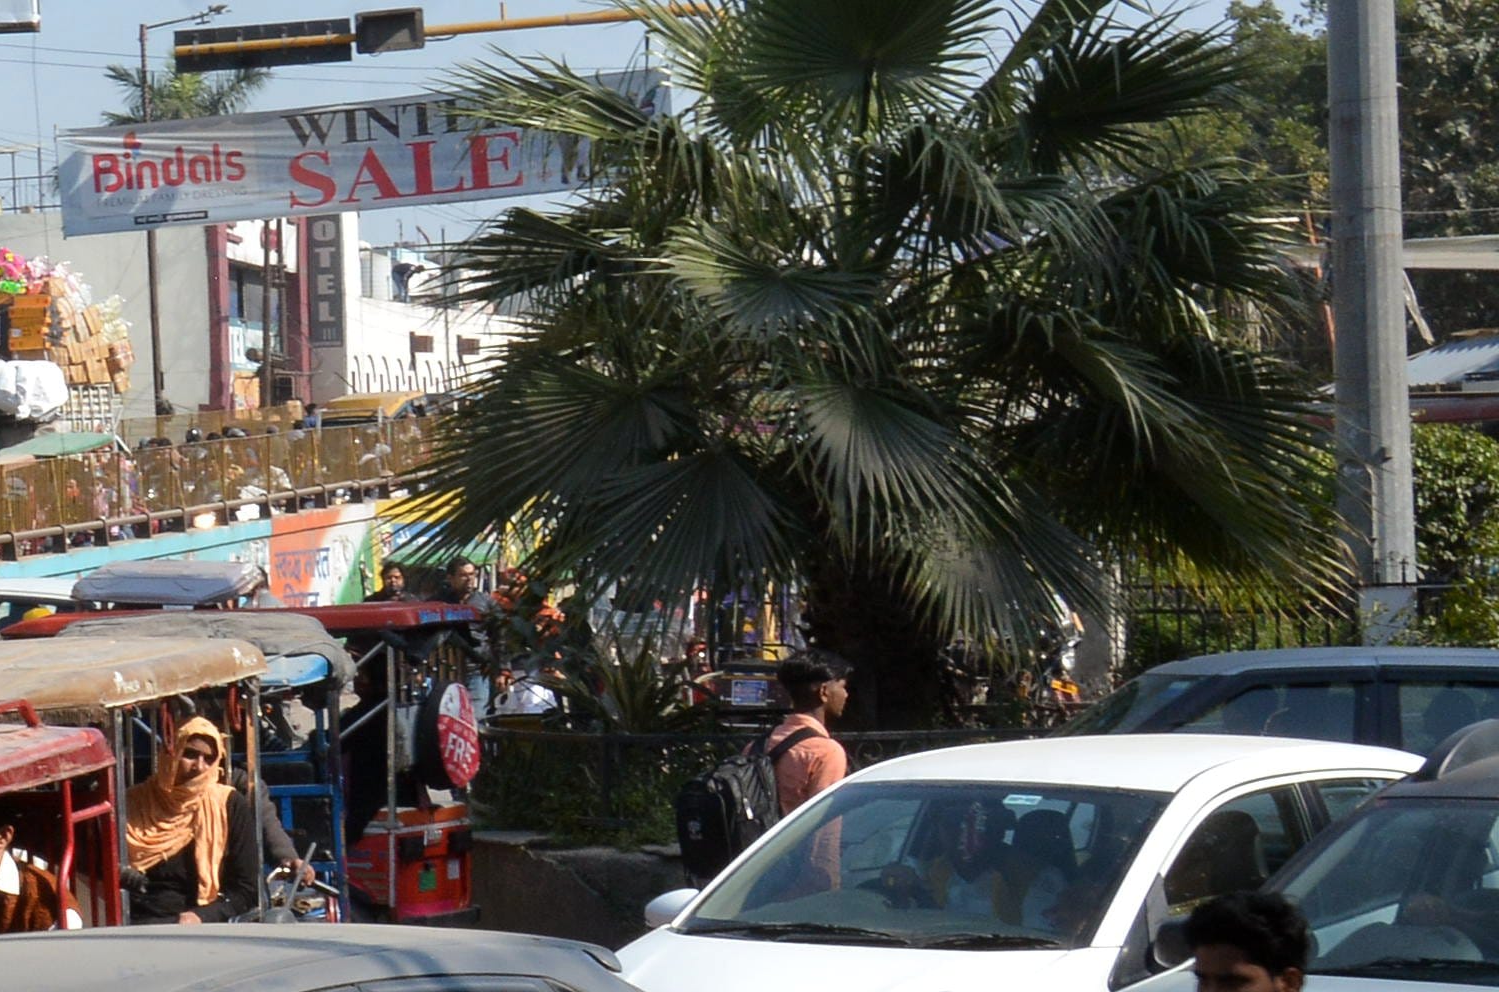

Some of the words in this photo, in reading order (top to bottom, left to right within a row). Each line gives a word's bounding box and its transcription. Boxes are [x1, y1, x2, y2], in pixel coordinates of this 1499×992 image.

[281, 100, 500, 147] WINTE
[92, 143, 246, 193] Bindals
[289, 131, 524, 209] SALE
[313, 220, 336, 323] OTEL
